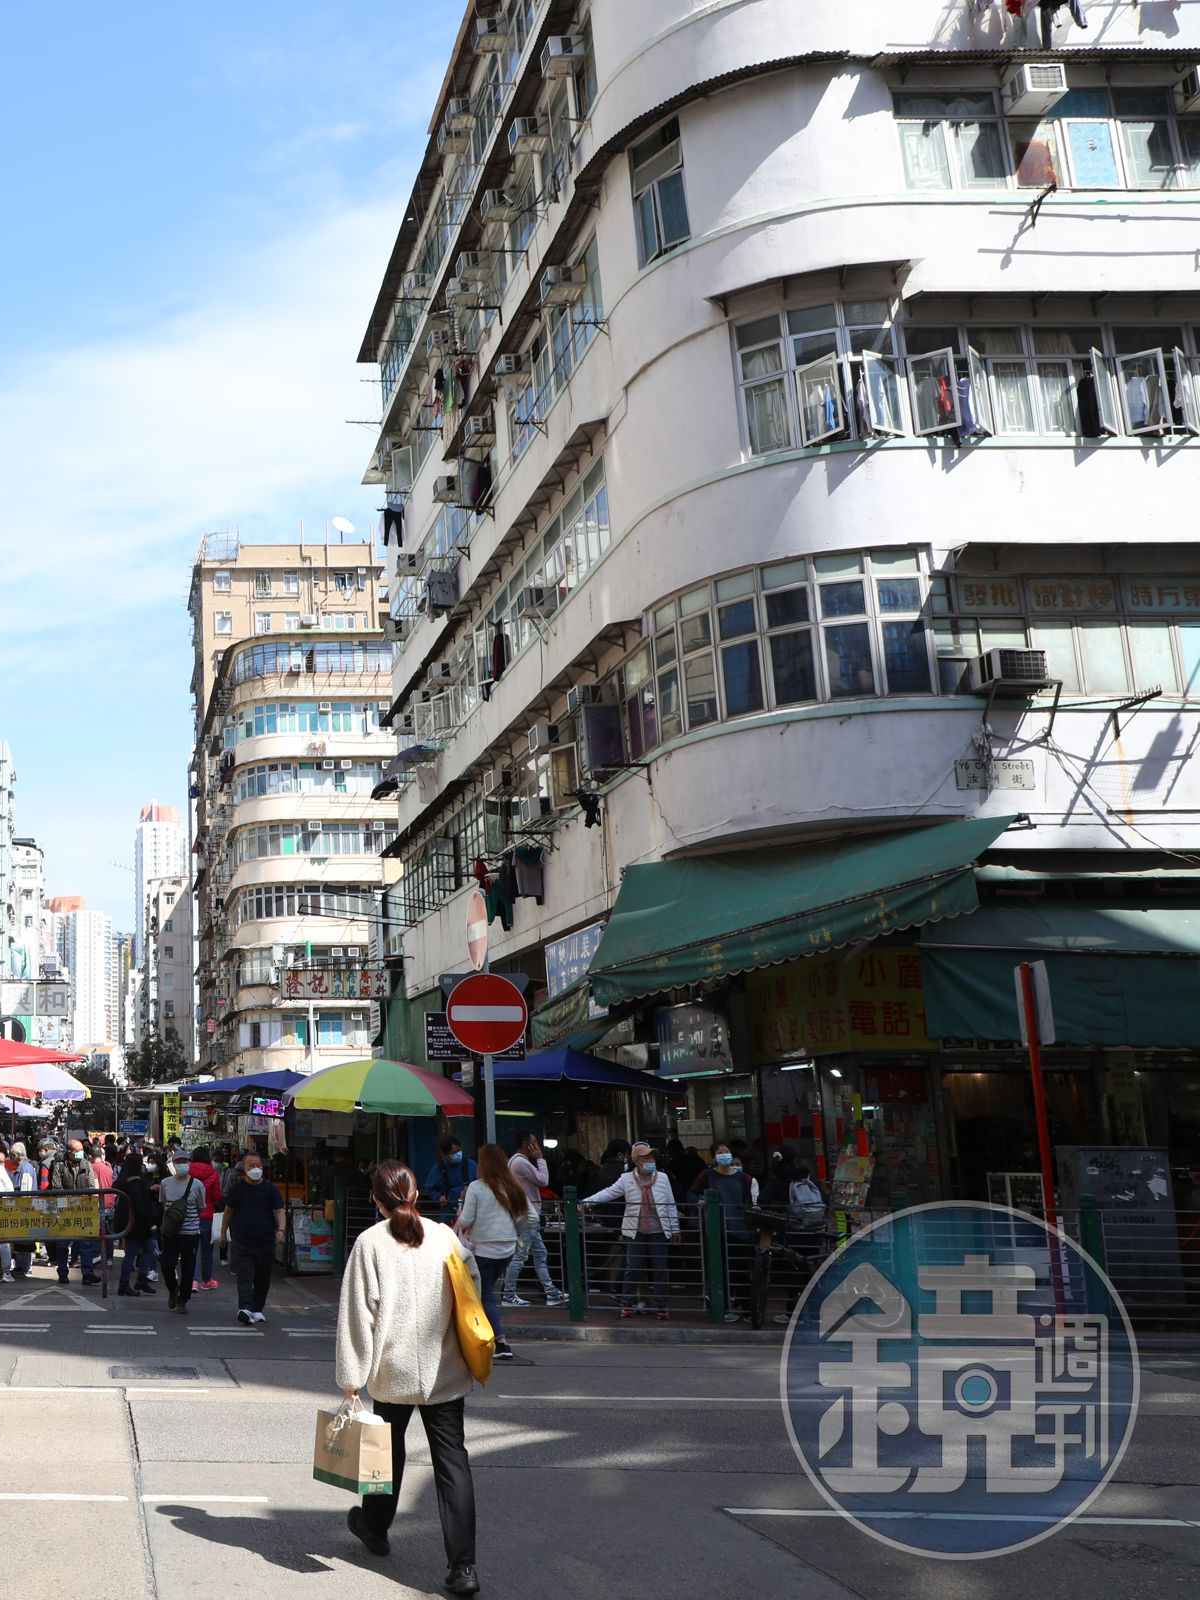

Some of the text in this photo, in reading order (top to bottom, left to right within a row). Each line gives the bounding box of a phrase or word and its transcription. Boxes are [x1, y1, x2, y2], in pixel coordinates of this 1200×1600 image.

[1002, 762, 1030, 770] Street
[285, 970, 329, 994] 隆記
[0, 1217, 94, 1229] 部份時間行人專用區
